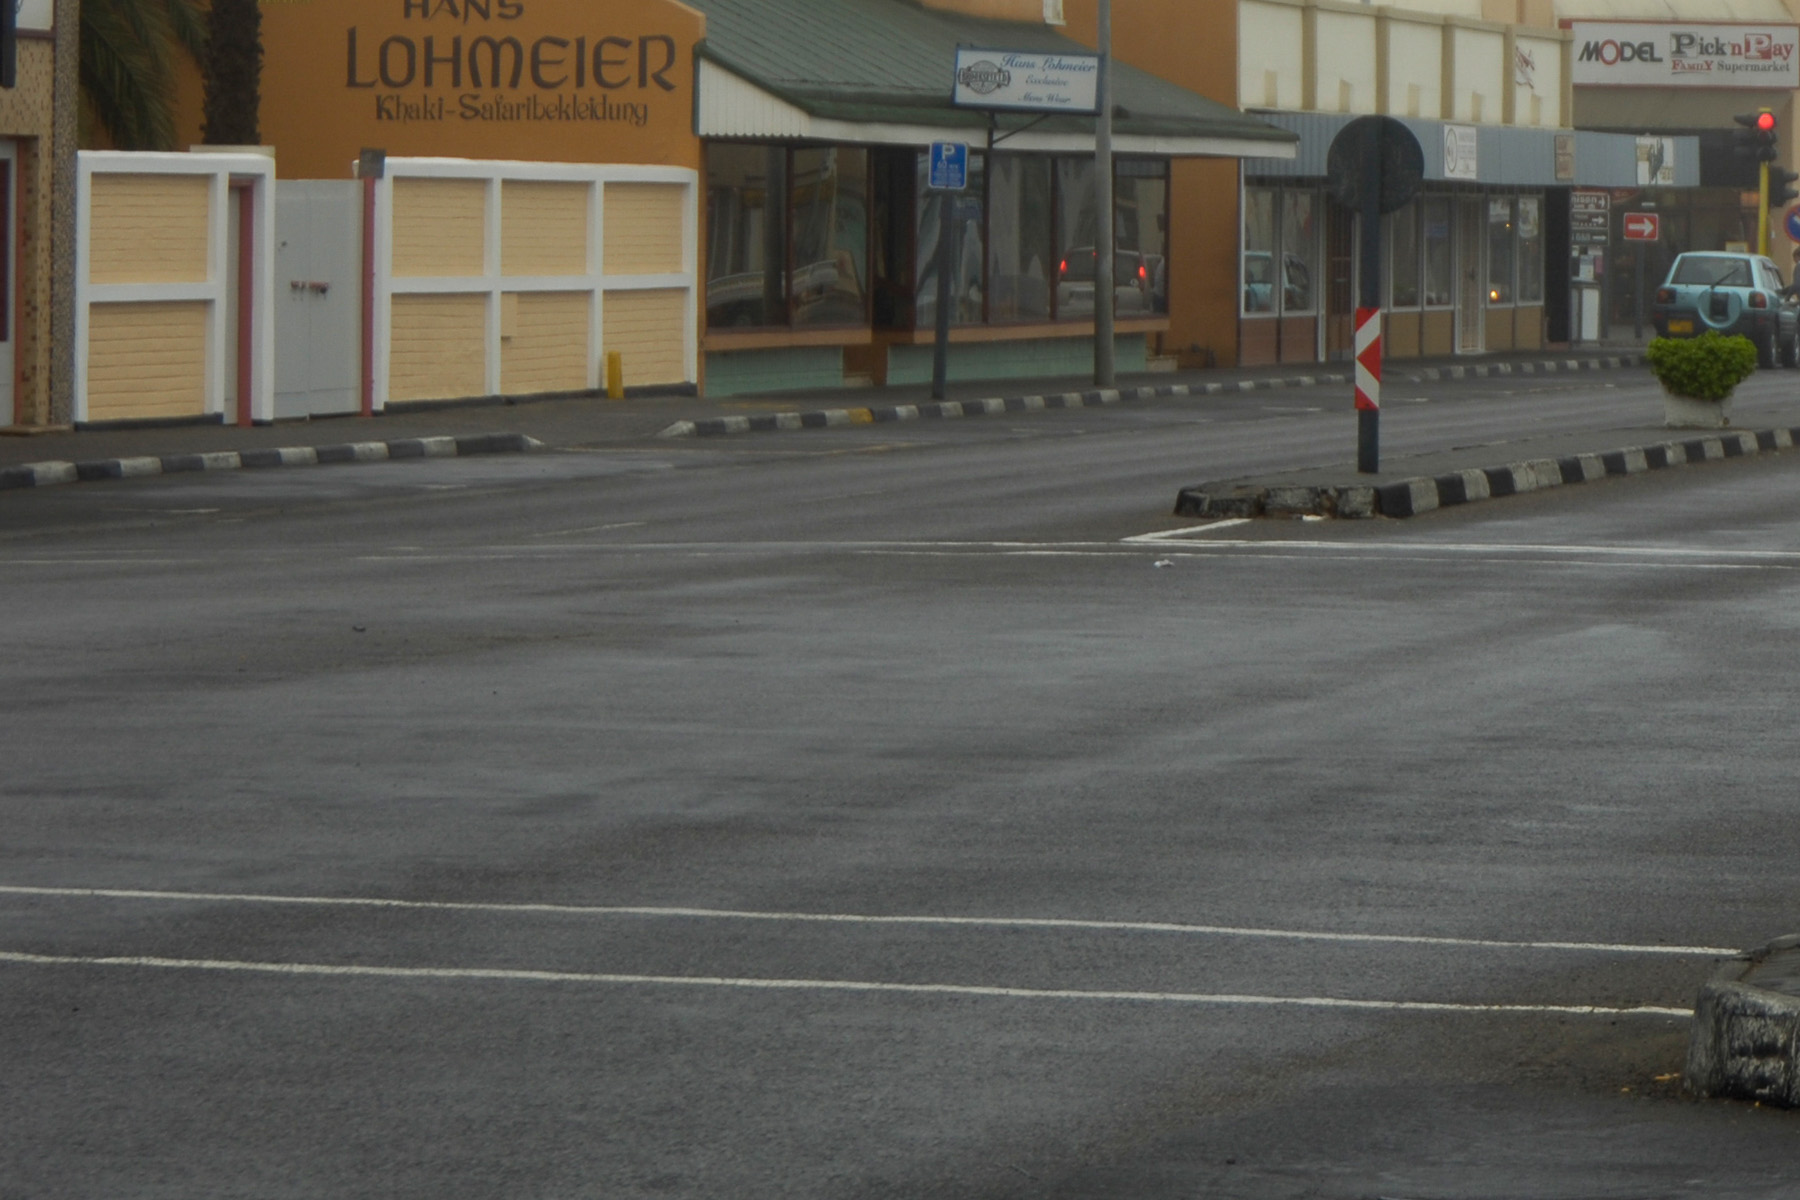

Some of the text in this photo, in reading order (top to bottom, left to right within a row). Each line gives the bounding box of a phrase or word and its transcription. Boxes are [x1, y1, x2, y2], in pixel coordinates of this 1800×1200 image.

[345, 25, 677, 92] LOHMEIER
[1578, 39, 1664, 66] MODEL
[1001, 53, 1037, 69] Hans
[1716, 60, 1790, 74] Supermarket
[942, 144, 955, 160] P
